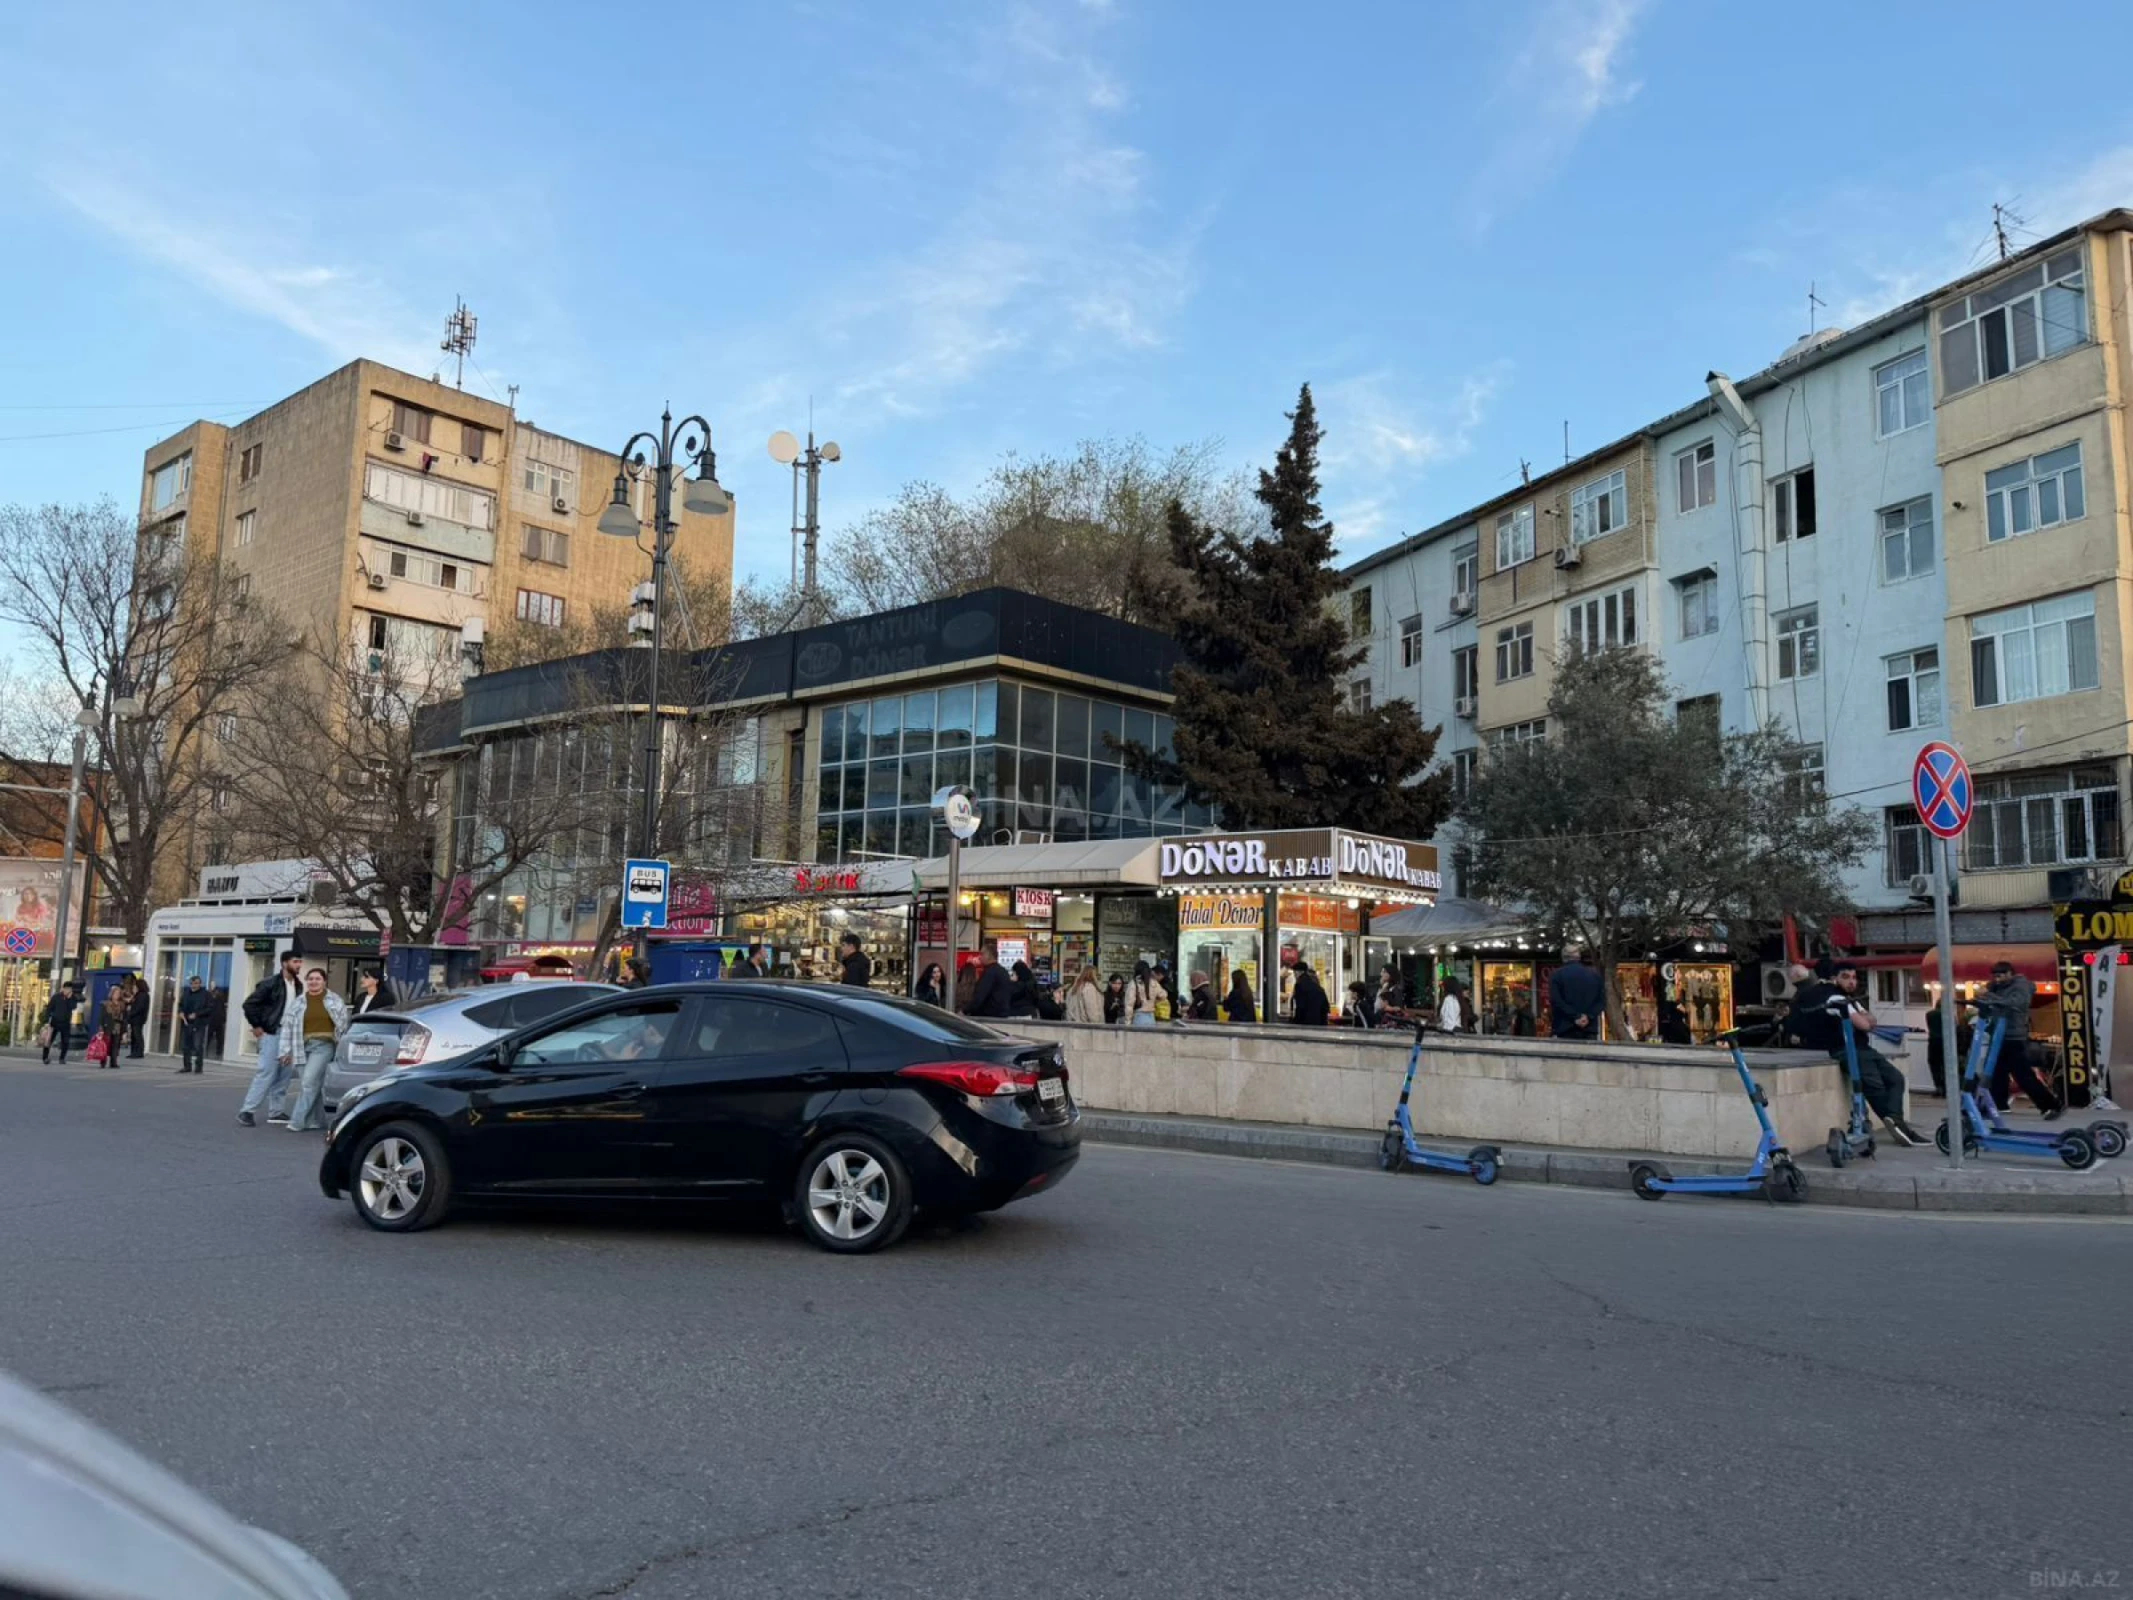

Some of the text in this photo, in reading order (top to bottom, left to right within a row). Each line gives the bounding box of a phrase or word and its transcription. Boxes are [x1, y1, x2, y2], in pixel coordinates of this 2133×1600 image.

[636, 869, 657, 878] BUS
[1268, 856, 1333, 878] KABAB
[1408, 868, 1442, 888] KABAB
[1181, 901, 1215, 925] Halal
[1218, 899, 1264, 925] Dönər
[2062, 959, 2086, 1085] LOMBARD
